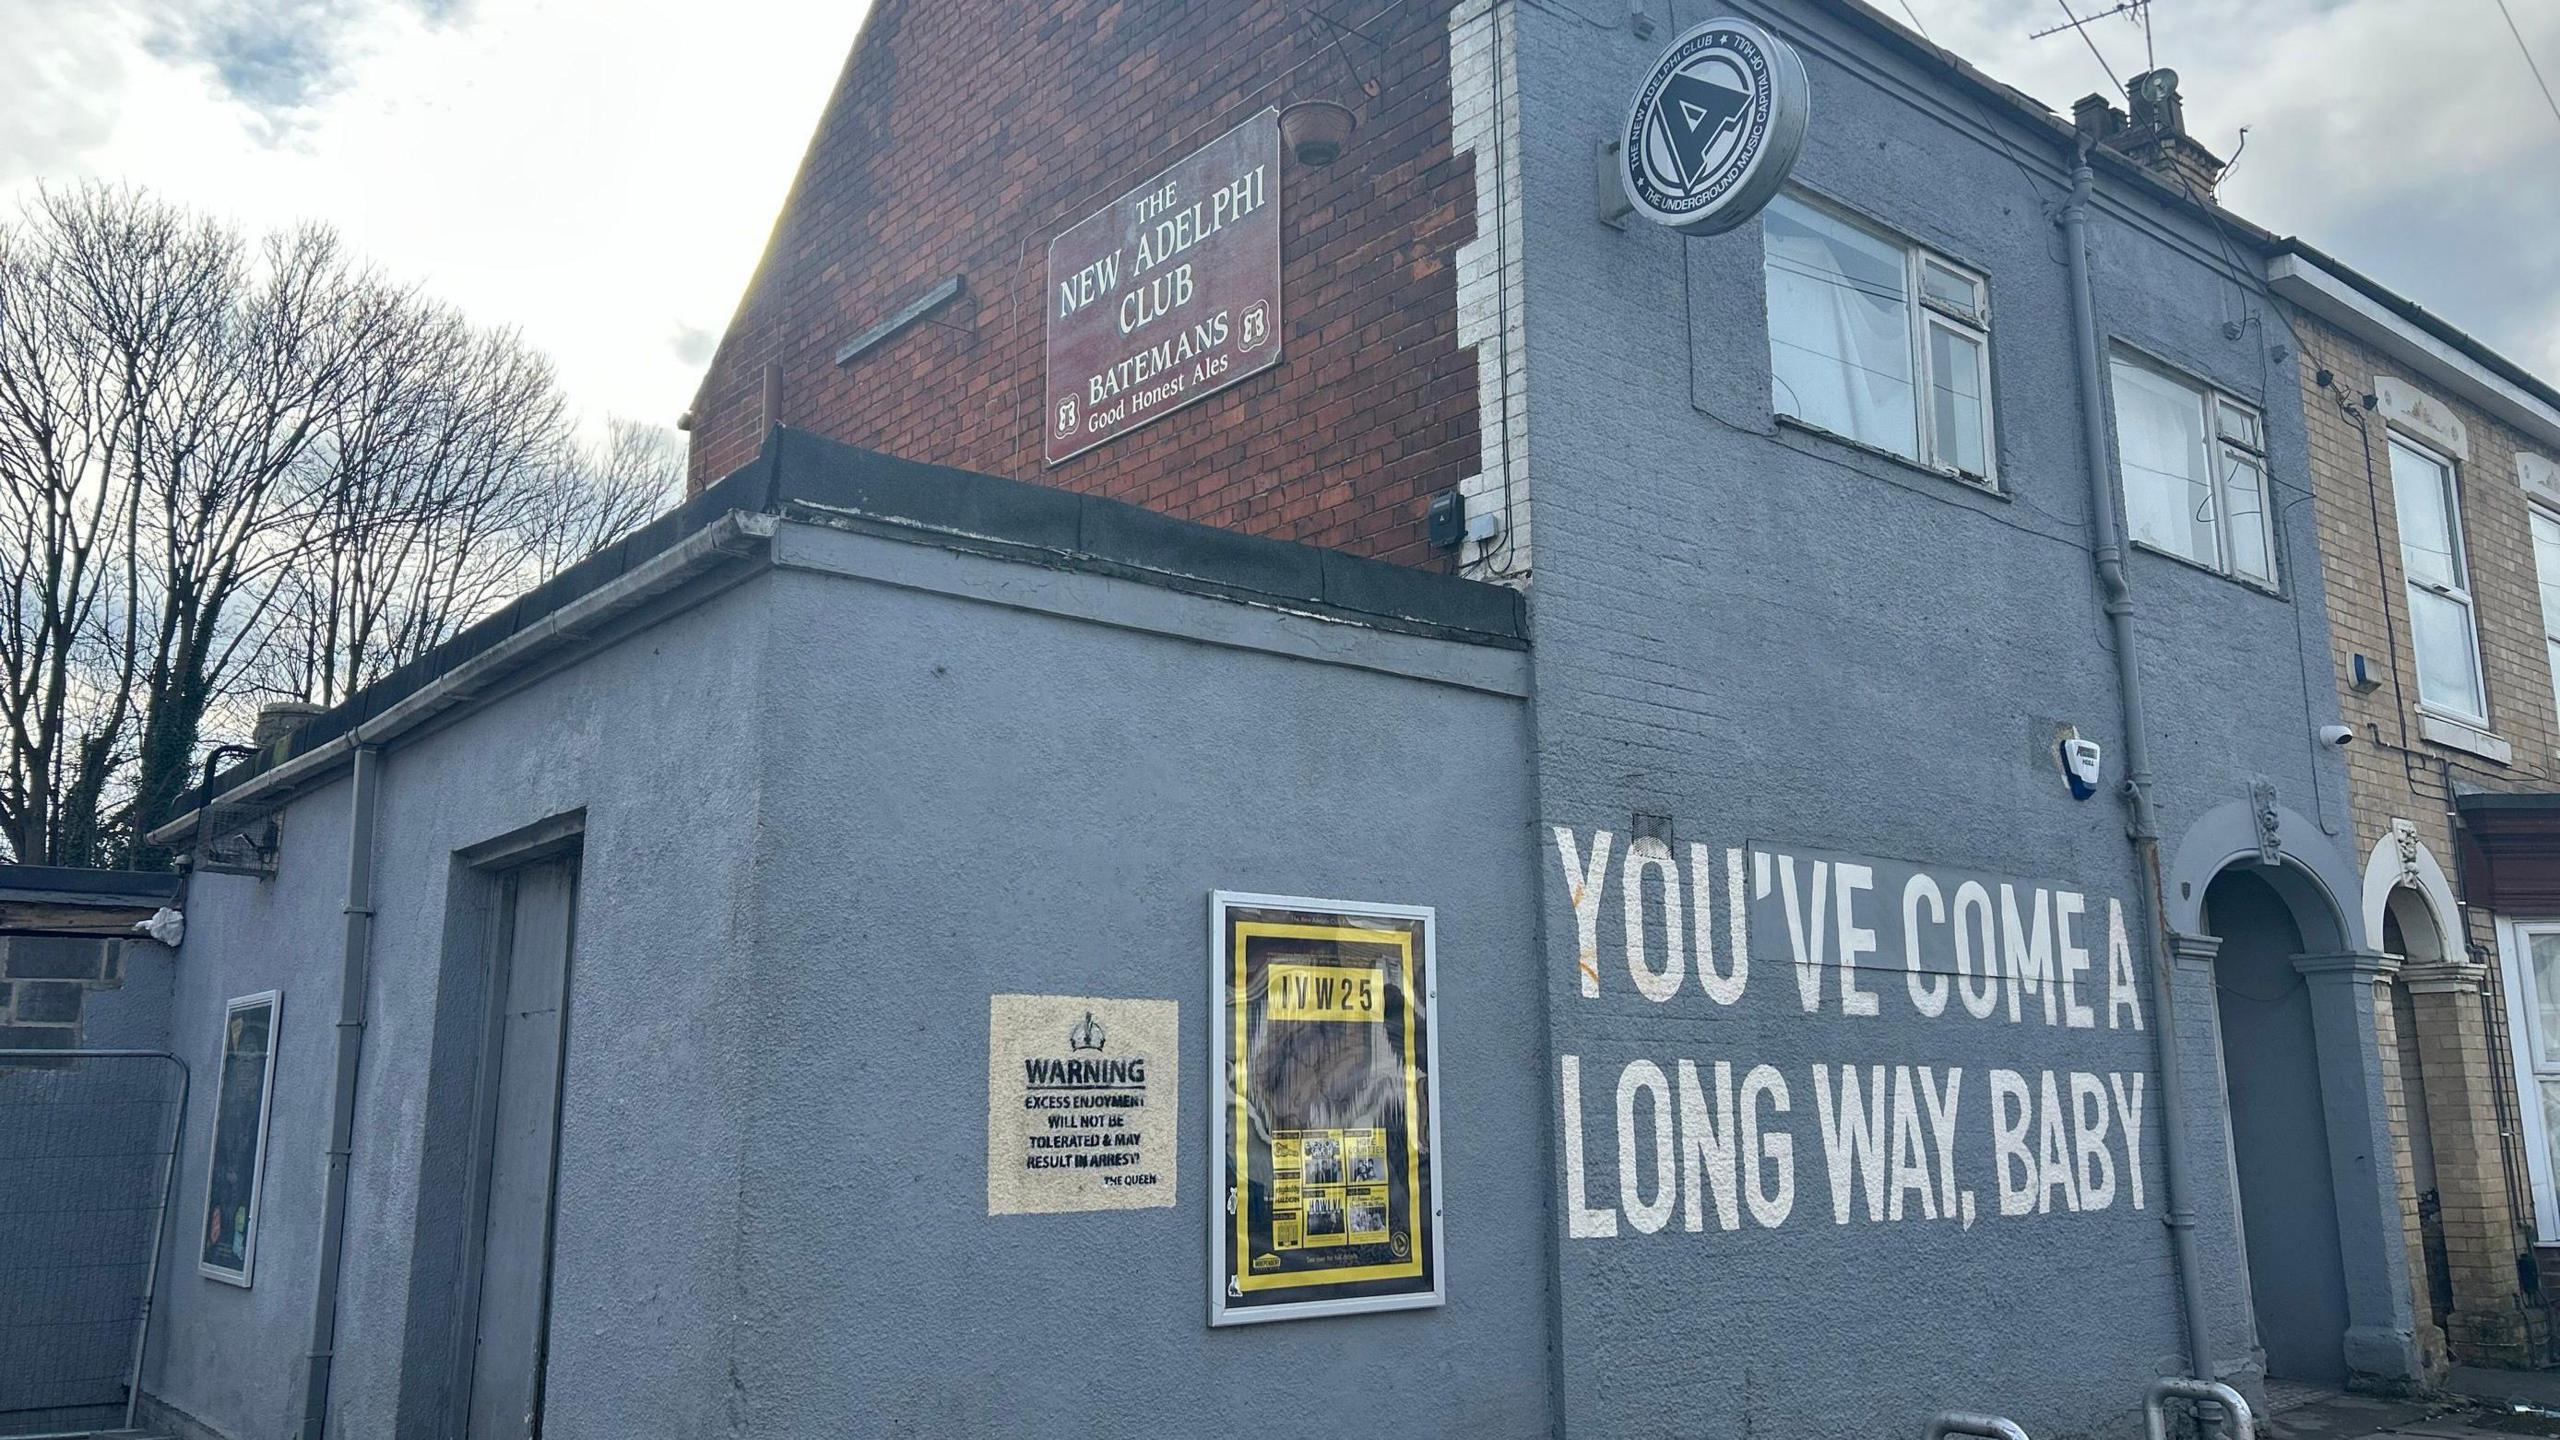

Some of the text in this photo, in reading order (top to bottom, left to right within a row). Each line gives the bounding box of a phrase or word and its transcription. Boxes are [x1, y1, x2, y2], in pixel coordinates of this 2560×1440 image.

[1630, 35, 1713, 171] THE NEW ADELPHI CLUB
[1645, 35, 1769, 210] THE UNDERGROUND MUSIC CAPITAL OF HULL
[1136, 181, 1177, 224] THE
[1060, 165, 1265, 318] NEW ADELPHI
[1120, 263, 1193, 334] CLUB
[1088, 354, 1229, 433] Good Honest Ales
[1089, 311, 1229, 406] BATEMANS
[1553, 826, 2144, 1031] YOU'VE COME A
[1025, 1059, 1145, 1084] WARNING
[1025, 1095, 1144, 1109] EXCESS ENJOYMENT
[1029, 1133, 1141, 1148] TOLERATED & MAY
[1048, 1115, 1125, 1128] WILL NOT BE
[1561, 1054, 2145, 1238] LONG WAY, BABY
[1026, 1154, 1073, 1169] RESULT
[1074, 1154, 1088, 1168] IN
[1104, 1173, 1158, 1186] THE QUEEN
